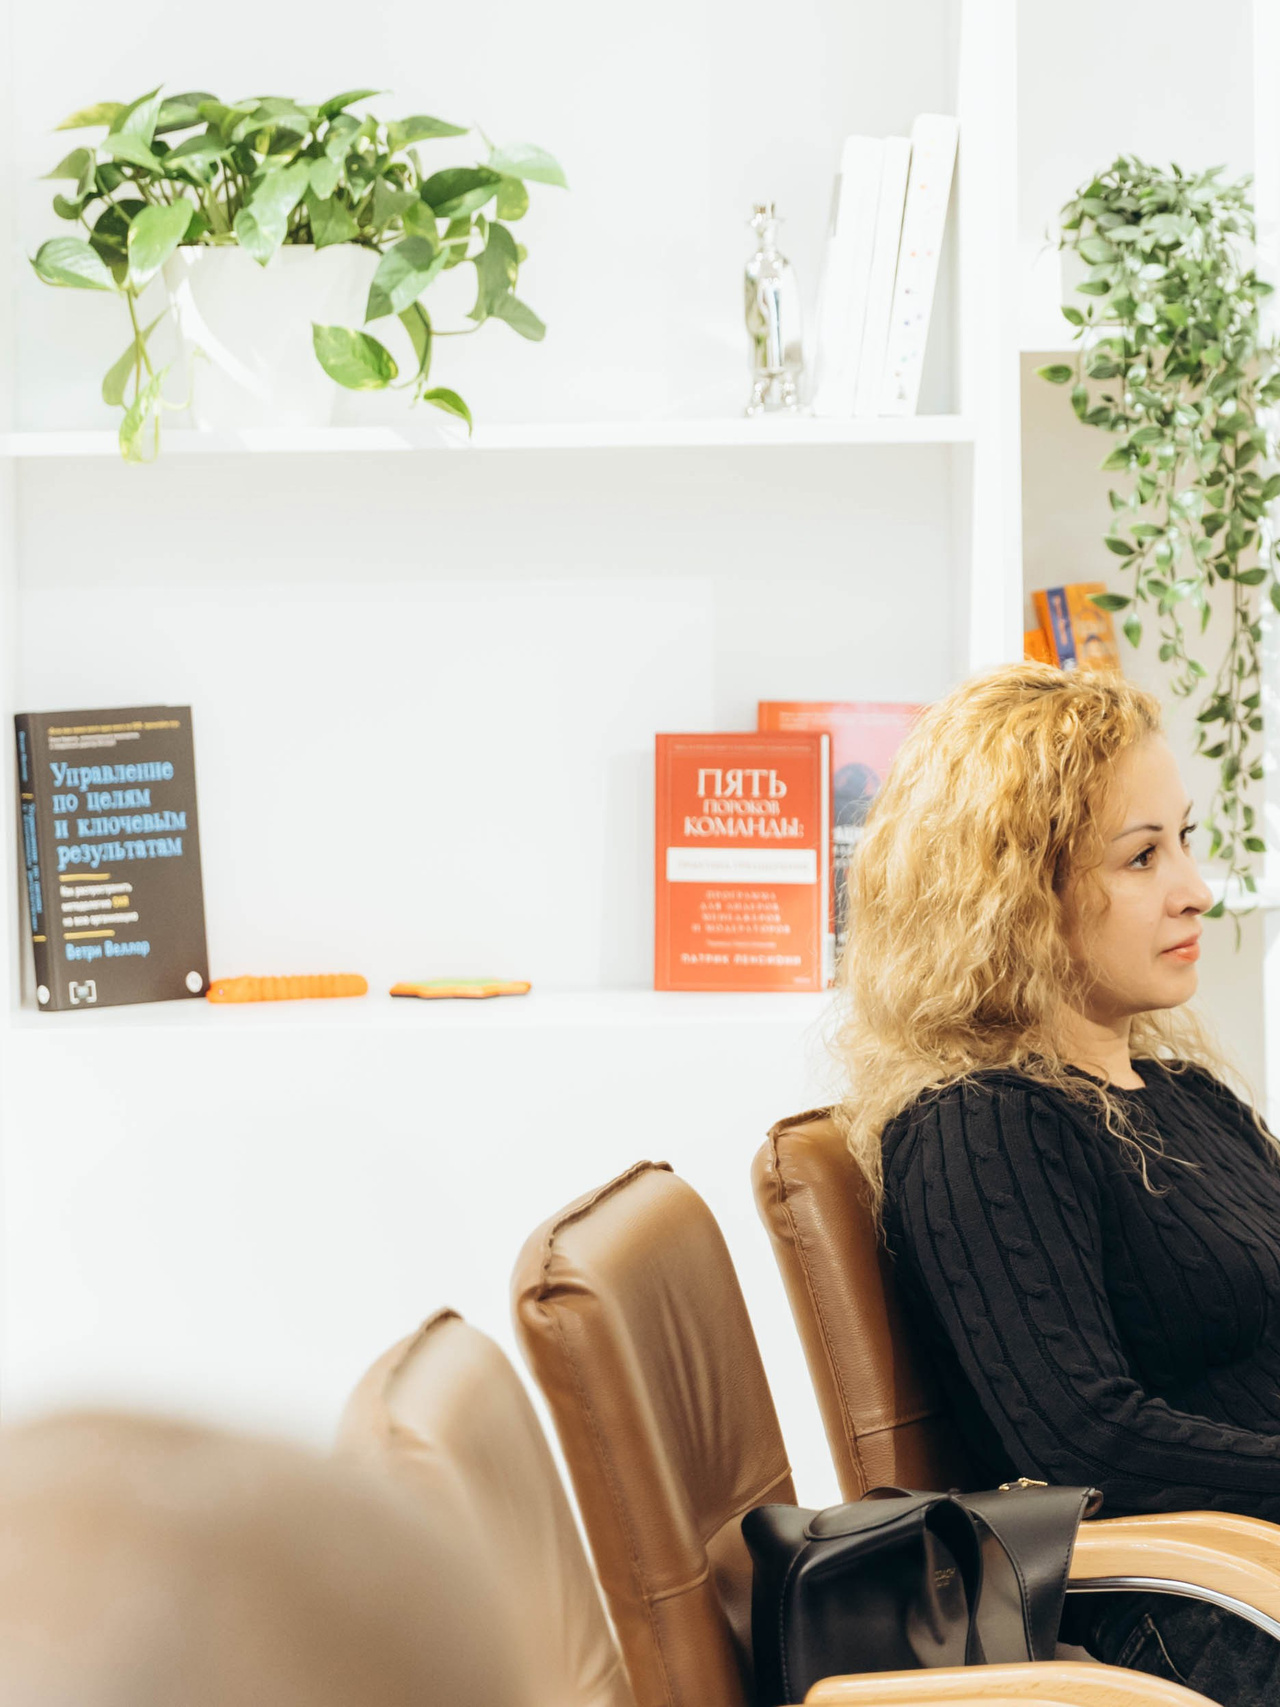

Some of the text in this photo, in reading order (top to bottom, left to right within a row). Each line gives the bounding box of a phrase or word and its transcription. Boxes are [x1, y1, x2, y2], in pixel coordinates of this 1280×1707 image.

[49, 761, 174, 792] Управление
[697, 768, 787, 798] ПЯТЬ
[52, 788, 151, 814] по целям
[703, 799, 780, 815] ПОРОКОВ
[54, 810, 187, 839] и ключевым
[56, 837, 183, 872] результатам
[705, 890, 777, 900] ПРОГРАММА
